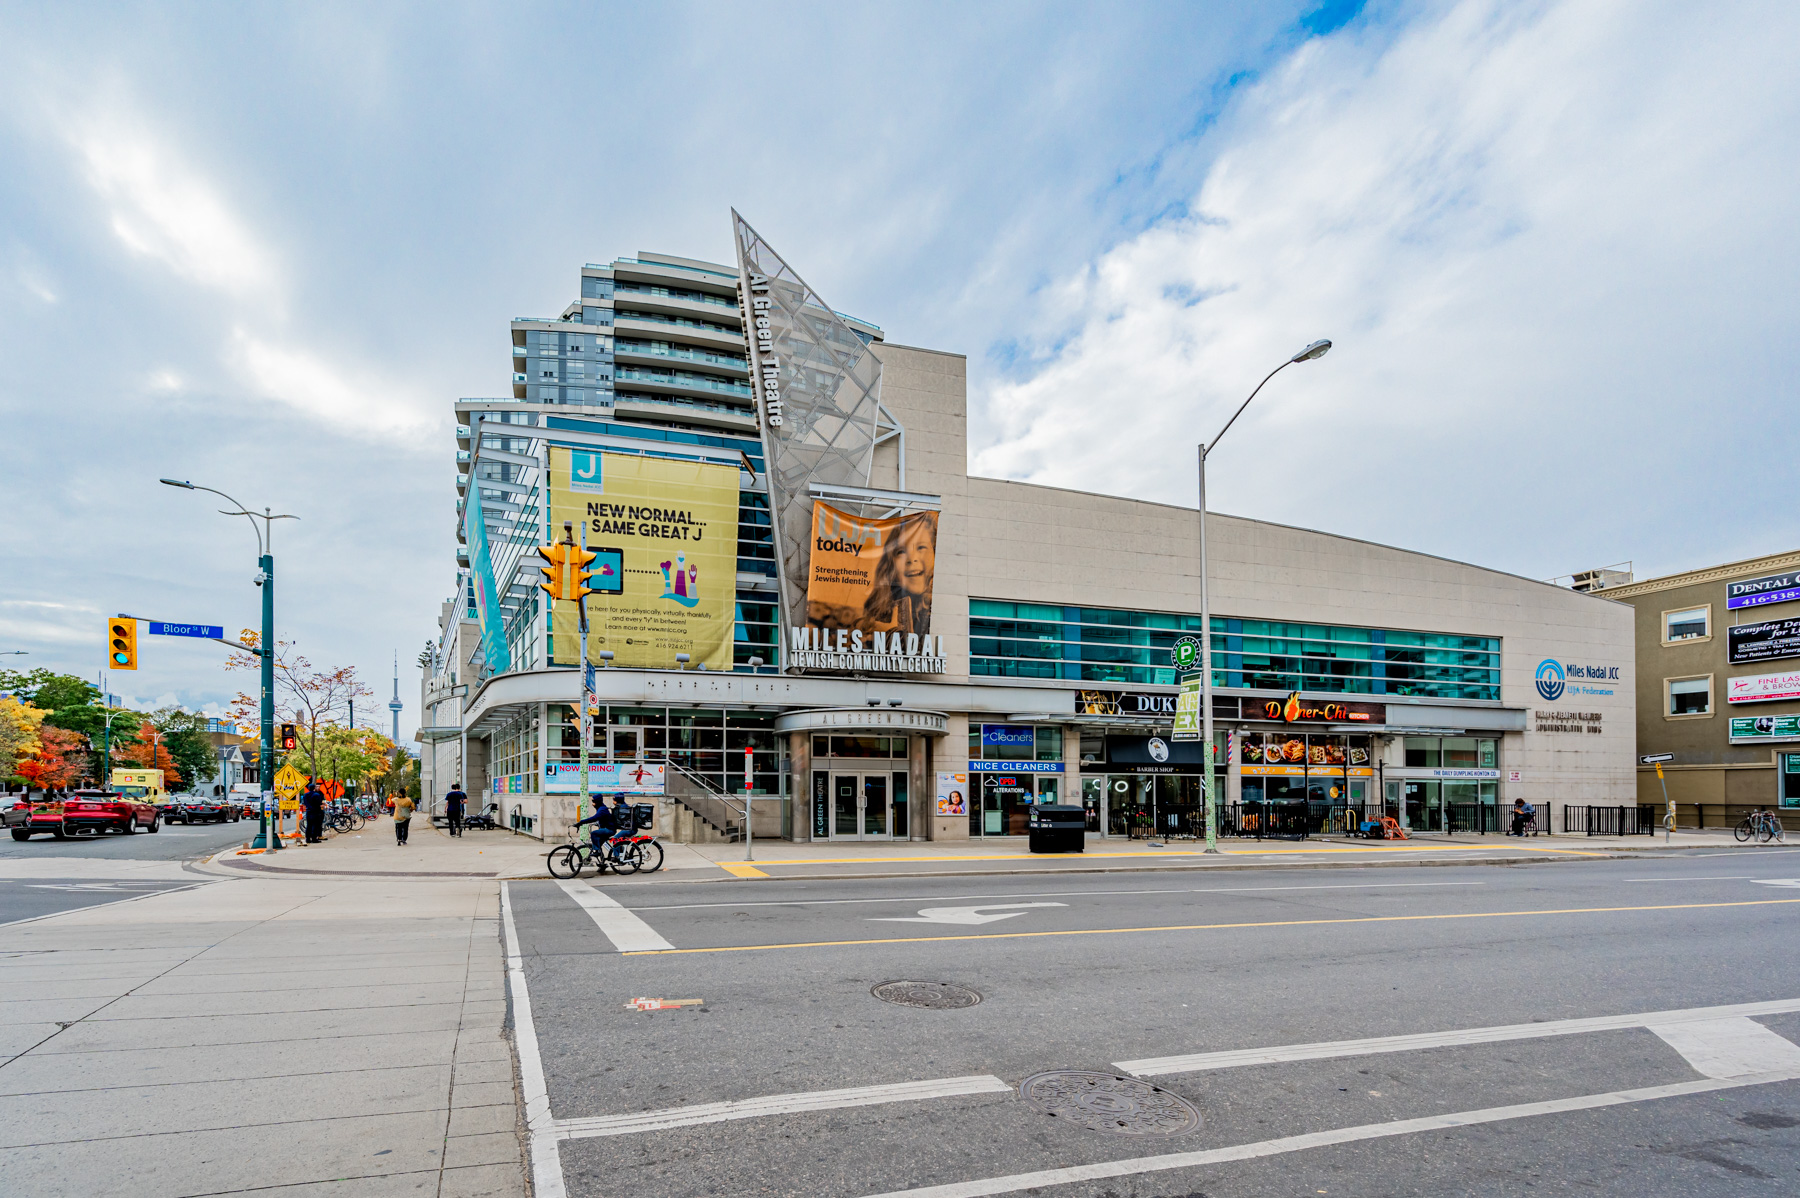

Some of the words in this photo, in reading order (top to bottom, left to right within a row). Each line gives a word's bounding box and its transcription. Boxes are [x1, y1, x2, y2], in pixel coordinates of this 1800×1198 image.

[749, 272, 769, 295] Al
[753, 297, 774, 352] Green
[760, 357, 784, 427] Theatre
[576, 454, 596, 479] J
[587, 502, 625, 518] NEW
[628, 506, 707, 526] NORMAL...
[592, 519, 635, 535] SAME
[638, 523, 689, 541] GREAT
[692, 528, 702, 541] J
[817, 506, 882, 547] UJA
[816, 536, 863, 557] today
[815, 566, 869, 577] Strengthening
[814, 575, 840, 584] Jewish
[841, 576, 871, 587] Identity
[1732, 578, 1791, 595] DENTAL
[619, 608, 631, 616] you
[163, 623, 191, 634] Bloor
[200, 626, 210, 635] W
[1733, 622, 1781, 635] Complete
[1767, 628, 1788, 640] for
[792, 626, 864, 653] MILES
[873, 630, 948, 658] NADAL
[1180, 645, 1192, 660] P
[1749, 650, 1772, 658] Patients
[792, 652, 834, 669] JEWISH
[839, 654, 904, 672] COMMUNITY
[908, 657, 947, 674] CENTRE
[1566, 664, 1585, 678] Miles
[1586, 665, 1607, 679] Nadal
[1608, 667, 1619, 680] JCC
[1758, 677, 1779, 685] FINE
[1567, 685, 1580, 696] UJA
[1582, 686, 1614, 696] Federation
[1136, 696, 1178, 713] DUK
[822, 714, 837, 724] AL
[847, 713, 892, 724] GREEN
[901, 714, 943, 728] THEATRE
[989, 732, 1033, 742] Cleaners
[973, 762, 998, 770] NICE
[1001, 763, 1057, 771] CLEANERS
[816, 777, 824, 802] THEATRE
